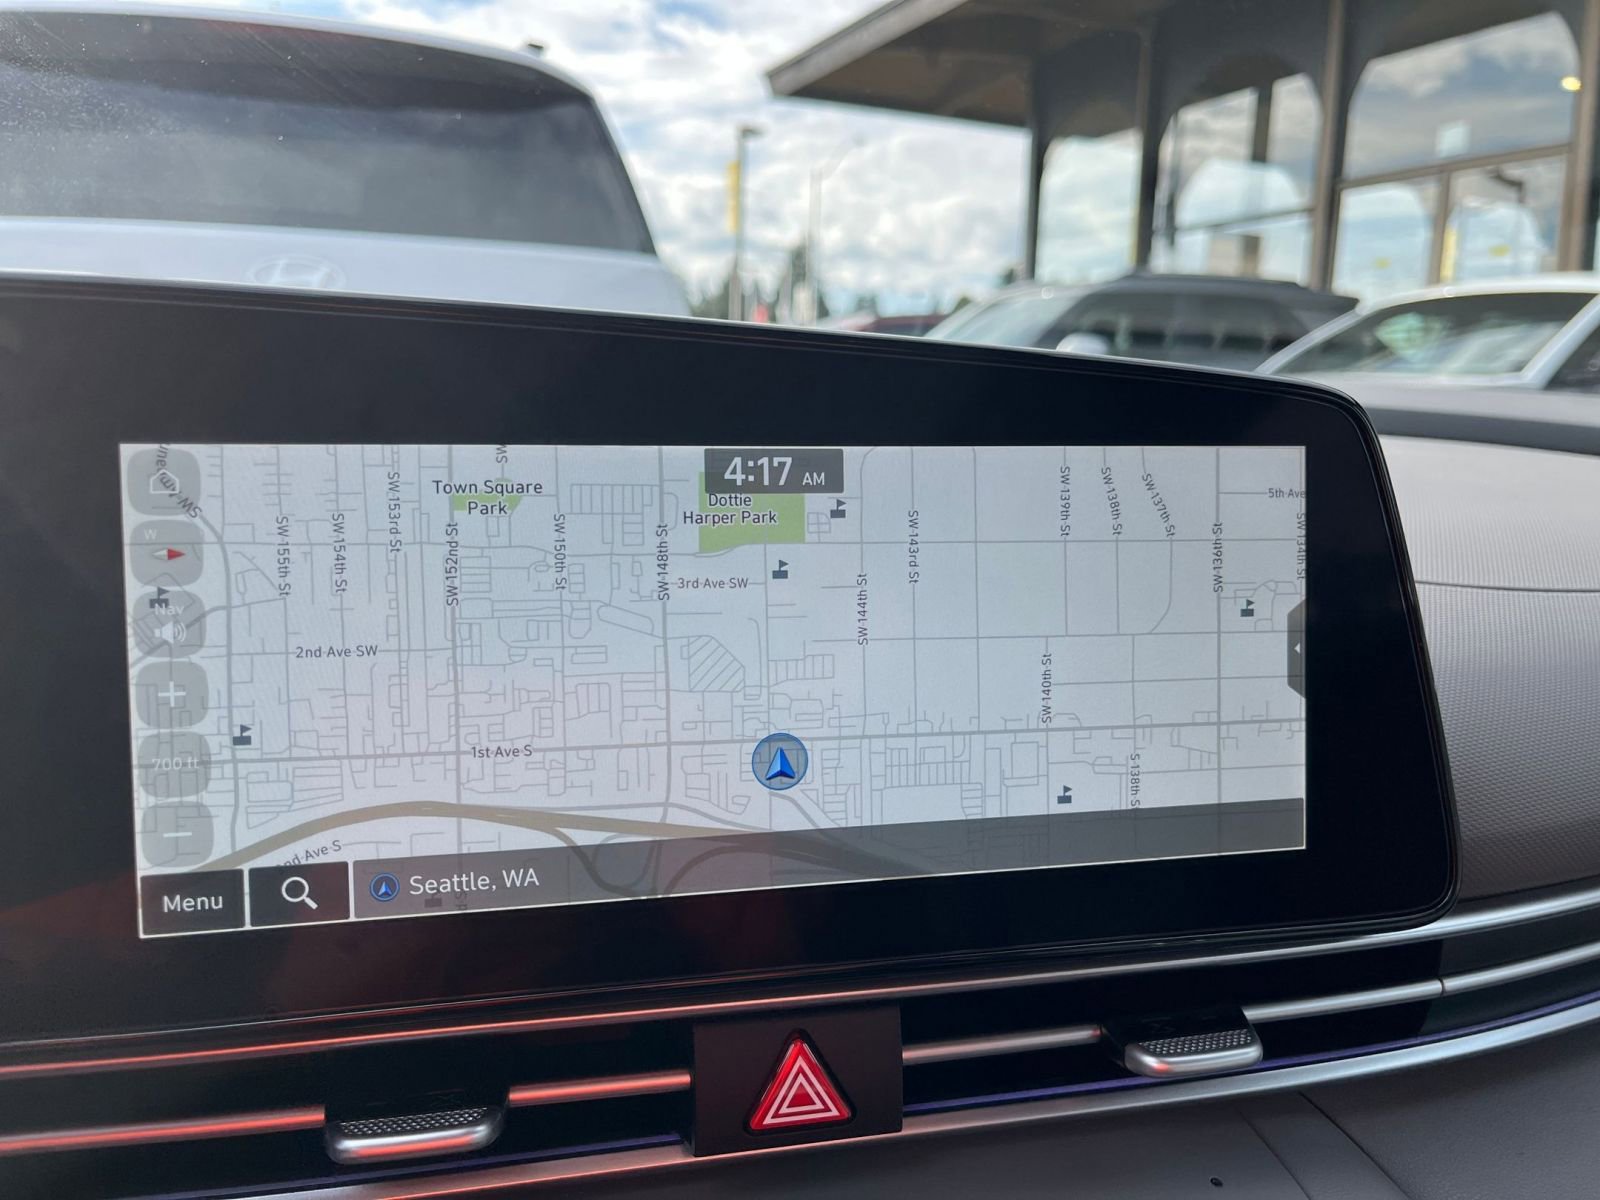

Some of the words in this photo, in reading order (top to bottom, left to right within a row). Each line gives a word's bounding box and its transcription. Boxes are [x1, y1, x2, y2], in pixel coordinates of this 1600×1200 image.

[724, 457, 792, 486] 4:17
[802, 472, 825, 486] AM
[1060, 466, 1070, 485] SW
[1101, 467, 1112, 484] SW
[388, 472, 400, 492] SW
[432, 480, 478, 494] Town
[484, 480, 543, 496] Square
[708, 493, 752, 506] Dottie
[1268, 488, 1284, 498] 5th
[1288, 488, 1306, 498] Ave
[468, 501, 508, 514] Park
[1060, 490, 1070, 520] 139th
[1106, 488, 1119, 521] 138th
[1142, 474, 1154, 492] SW
[1150, 493, 1170, 522] 137th
[1165, 524, 1176, 538] St
[332, 513, 344, 534] SW
[388, 497, 401, 535] 153rd
[554, 514, 565, 533] SW
[683, 512, 736, 527] Harper
[741, 511, 777, 524] Park
[908, 510, 918, 529] SW
[144, 529, 157, 540] W
[276, 516, 289, 538] SW
[446, 522, 458, 537] St
[656, 524, 668, 538] St
[1060, 525, 1070, 536] St
[1112, 523, 1122, 536] St
[1212, 522, 1222, 534] St
[390, 539, 402, 553] St
[555, 537, 566, 572] 150th
[908, 533, 919, 568] 143rd
[277, 542, 290, 578] 155th
[333, 537, 346, 574] 154th
[446, 540, 458, 580] 152nd
[657, 542, 668, 578] 148th
[1212, 538, 1222, 572] 136th
[335, 578, 348, 593] St
[556, 577, 567, 590] St
[678, 578, 700, 588] 3rd
[703, 578, 726, 588] Ave
[729, 578, 748, 588] SW
[856, 574, 867, 587] St
[909, 570, 920, 584] St
[1213, 575, 1223, 592] SW
[279, 582, 291, 597] St
[446, 584, 458, 606] SW
[658, 580, 670, 600] SW
[155, 604, 184, 615] Nav
[857, 590, 868, 622] 144th
[858, 626, 868, 645] SW
[296, 647, 323, 658] 2nd
[327, 646, 352, 658] Ave
[356, 646, 378, 656] SW
[1042, 654, 1052, 666] St
[1042, 670, 1052, 701] 140th
[1042, 706, 1052, 723] SW
[471, 747, 490, 758] 1st
[494, 746, 520, 758] Ave
[524, 745, 532, 756] S
[152, 758, 182, 770] 700
[185, 757, 200, 769] ft
[1130, 765, 1140, 795] 138th
[1130, 800, 1140, 808] S
[276, 854, 302, 867] nd
[305, 846, 328, 861] Ave
[332, 840, 342, 852] S
[410, 872, 497, 895] Seattle,
[502, 868, 540, 888] WA
[163, 895, 223, 912] Menu
